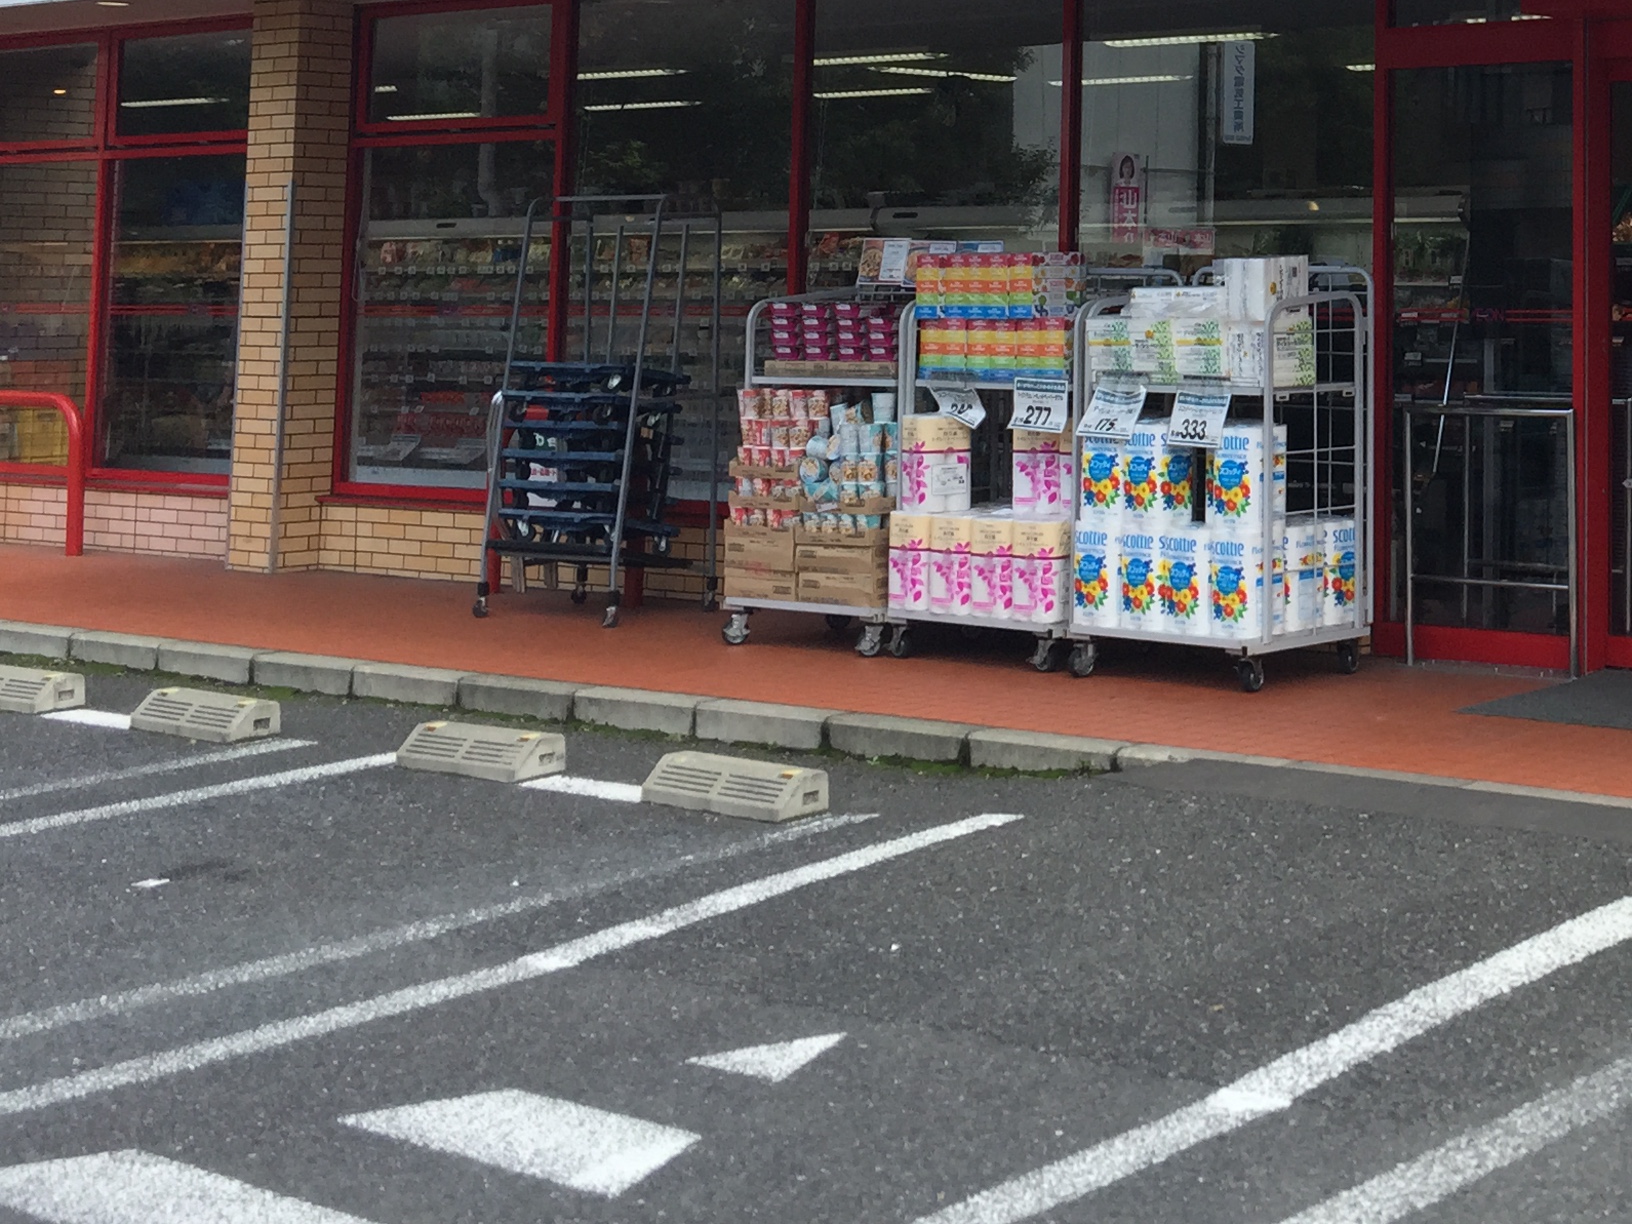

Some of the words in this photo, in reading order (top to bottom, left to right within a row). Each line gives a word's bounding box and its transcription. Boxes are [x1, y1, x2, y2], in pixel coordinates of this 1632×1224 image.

[1023, 405, 1052, 426] 277
[1094, 417, 1119, 432] 175
[1180, 418, 1208, 441] 333
